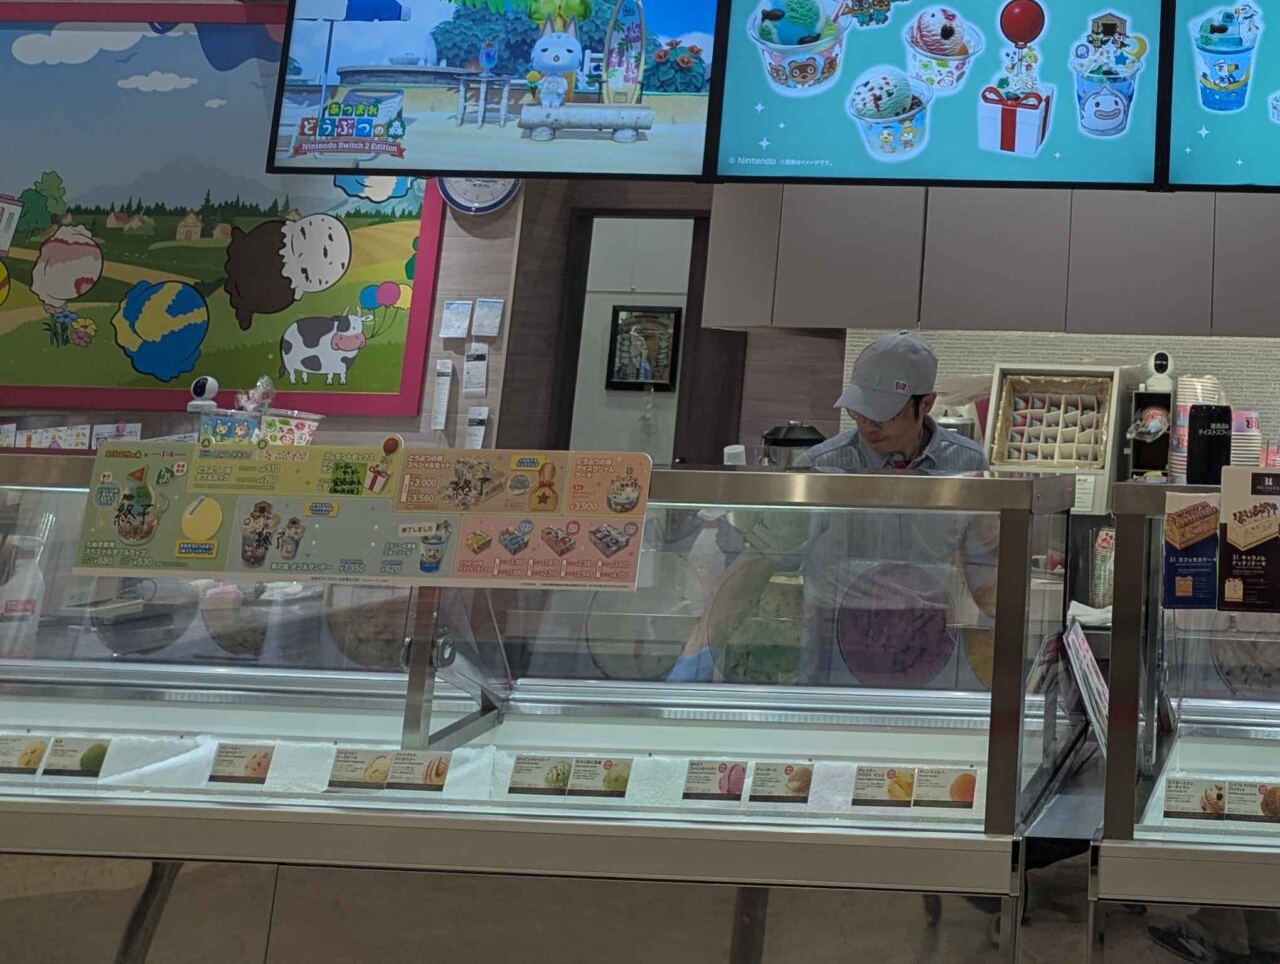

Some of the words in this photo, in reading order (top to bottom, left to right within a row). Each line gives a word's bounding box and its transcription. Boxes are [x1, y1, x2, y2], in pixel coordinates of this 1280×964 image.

[329, 103, 378, 115] あつまれ
[303, 118, 404, 136] どうぶつの森
[302, 141, 337, 150] Nintendo
[338, 141, 364, 149] Switch
[370, 142, 398, 152] Edition
[737, 156, 777, 165] Nintendo
[575, 465, 615, 473] アイスクリーム
